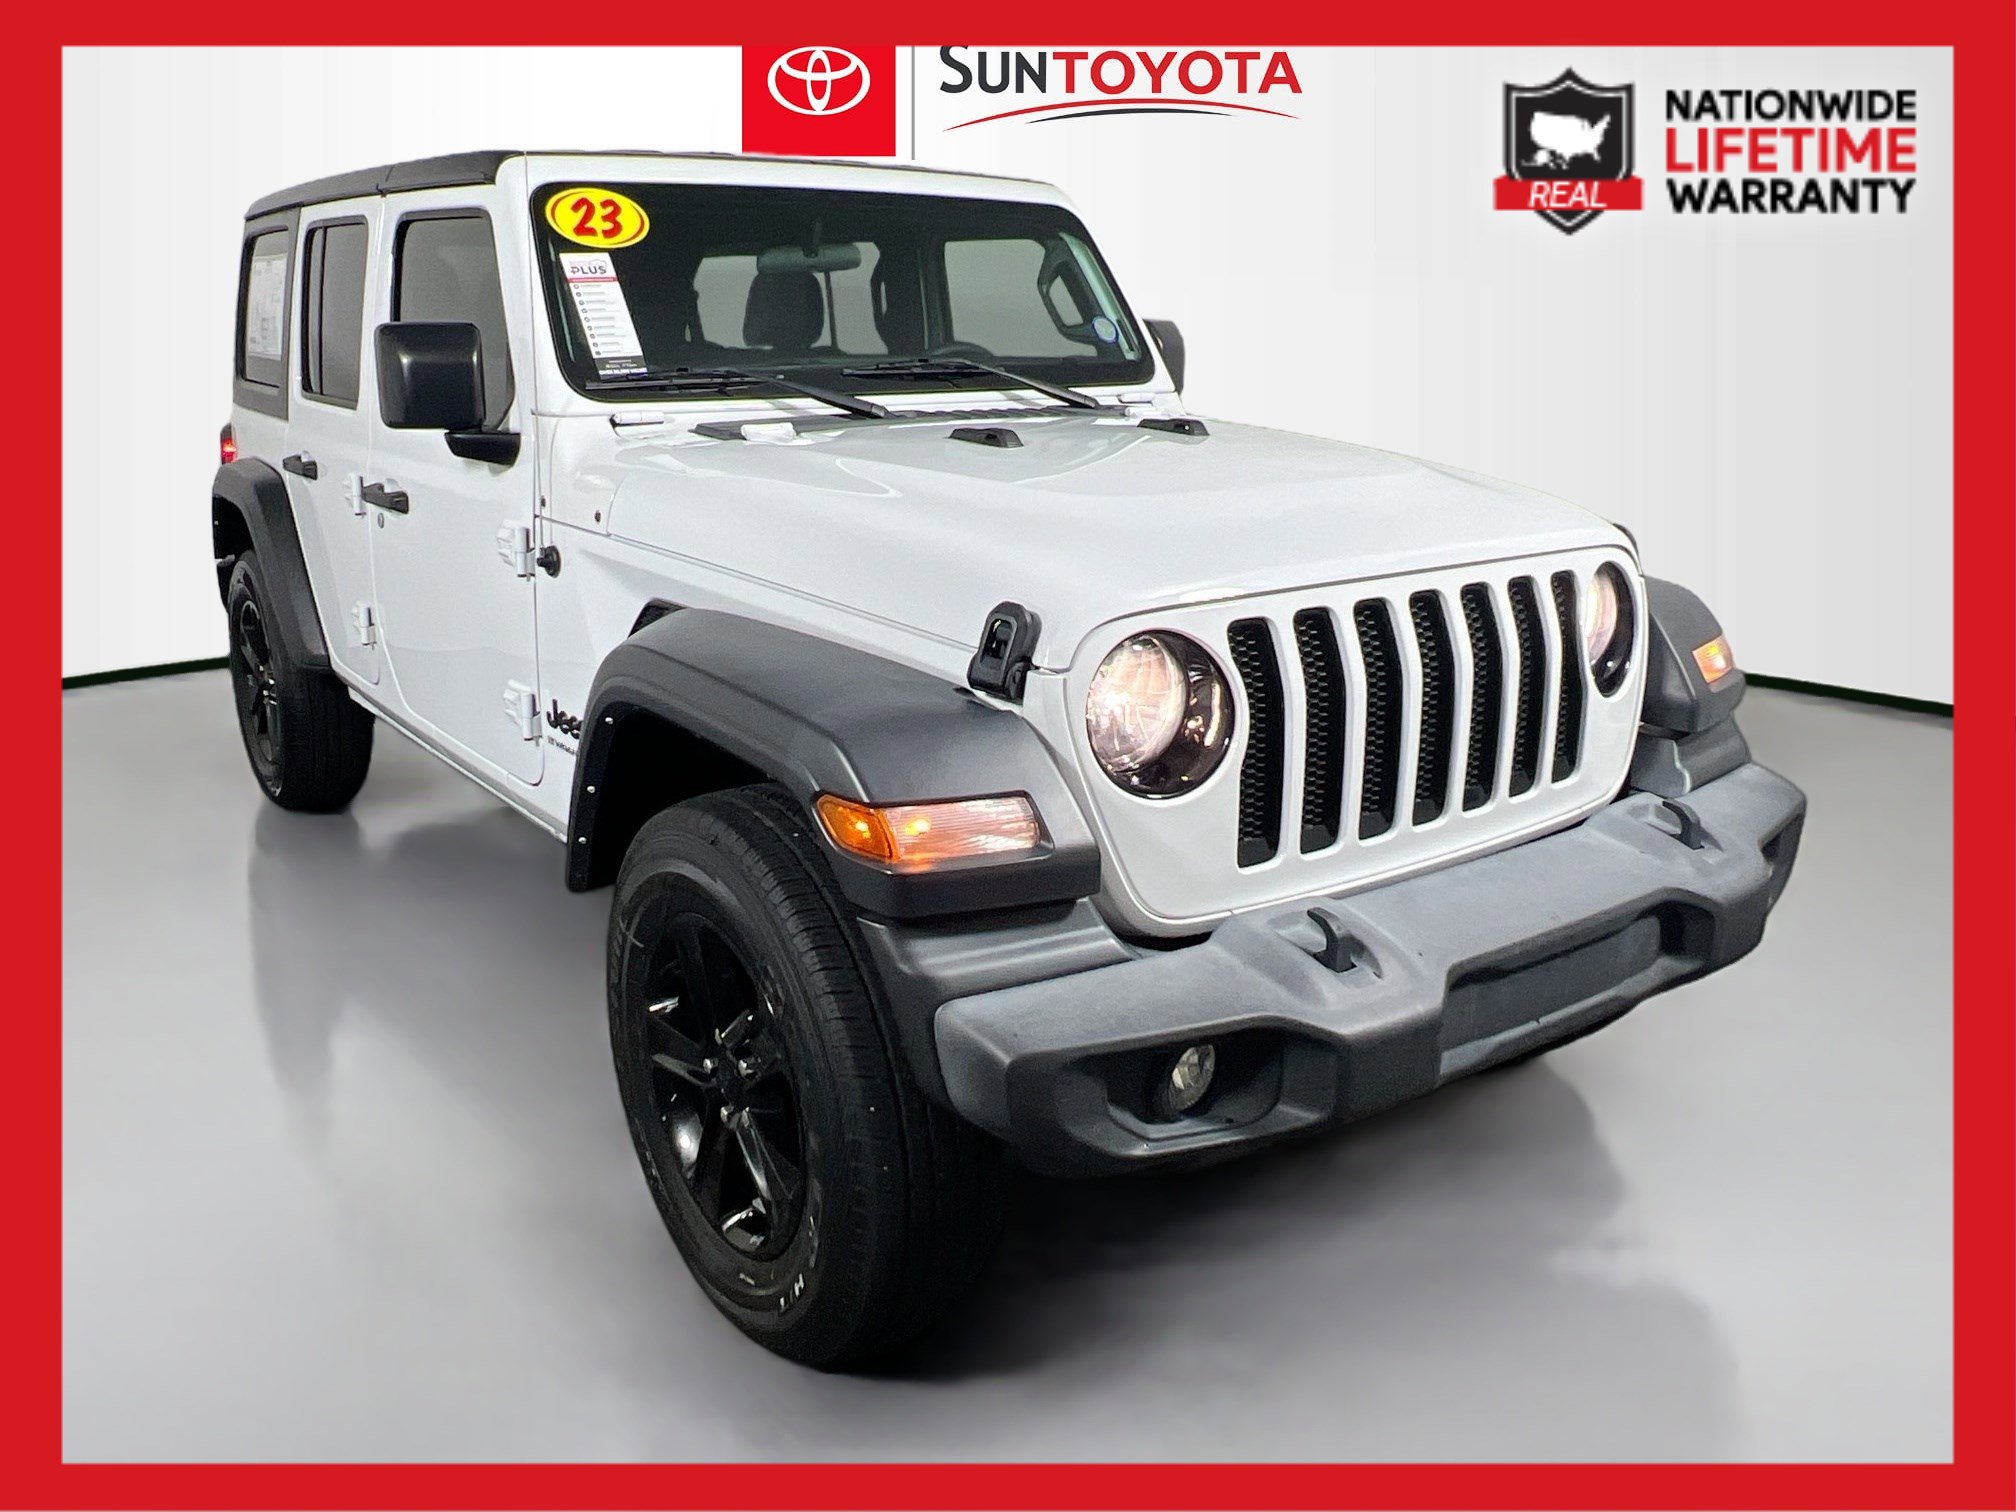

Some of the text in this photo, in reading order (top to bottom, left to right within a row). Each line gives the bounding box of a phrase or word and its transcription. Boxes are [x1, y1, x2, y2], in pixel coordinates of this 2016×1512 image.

[570, 197, 623, 239] 23
[570, 264, 608, 275] PLUS
[546, 699, 583, 740] Jee
